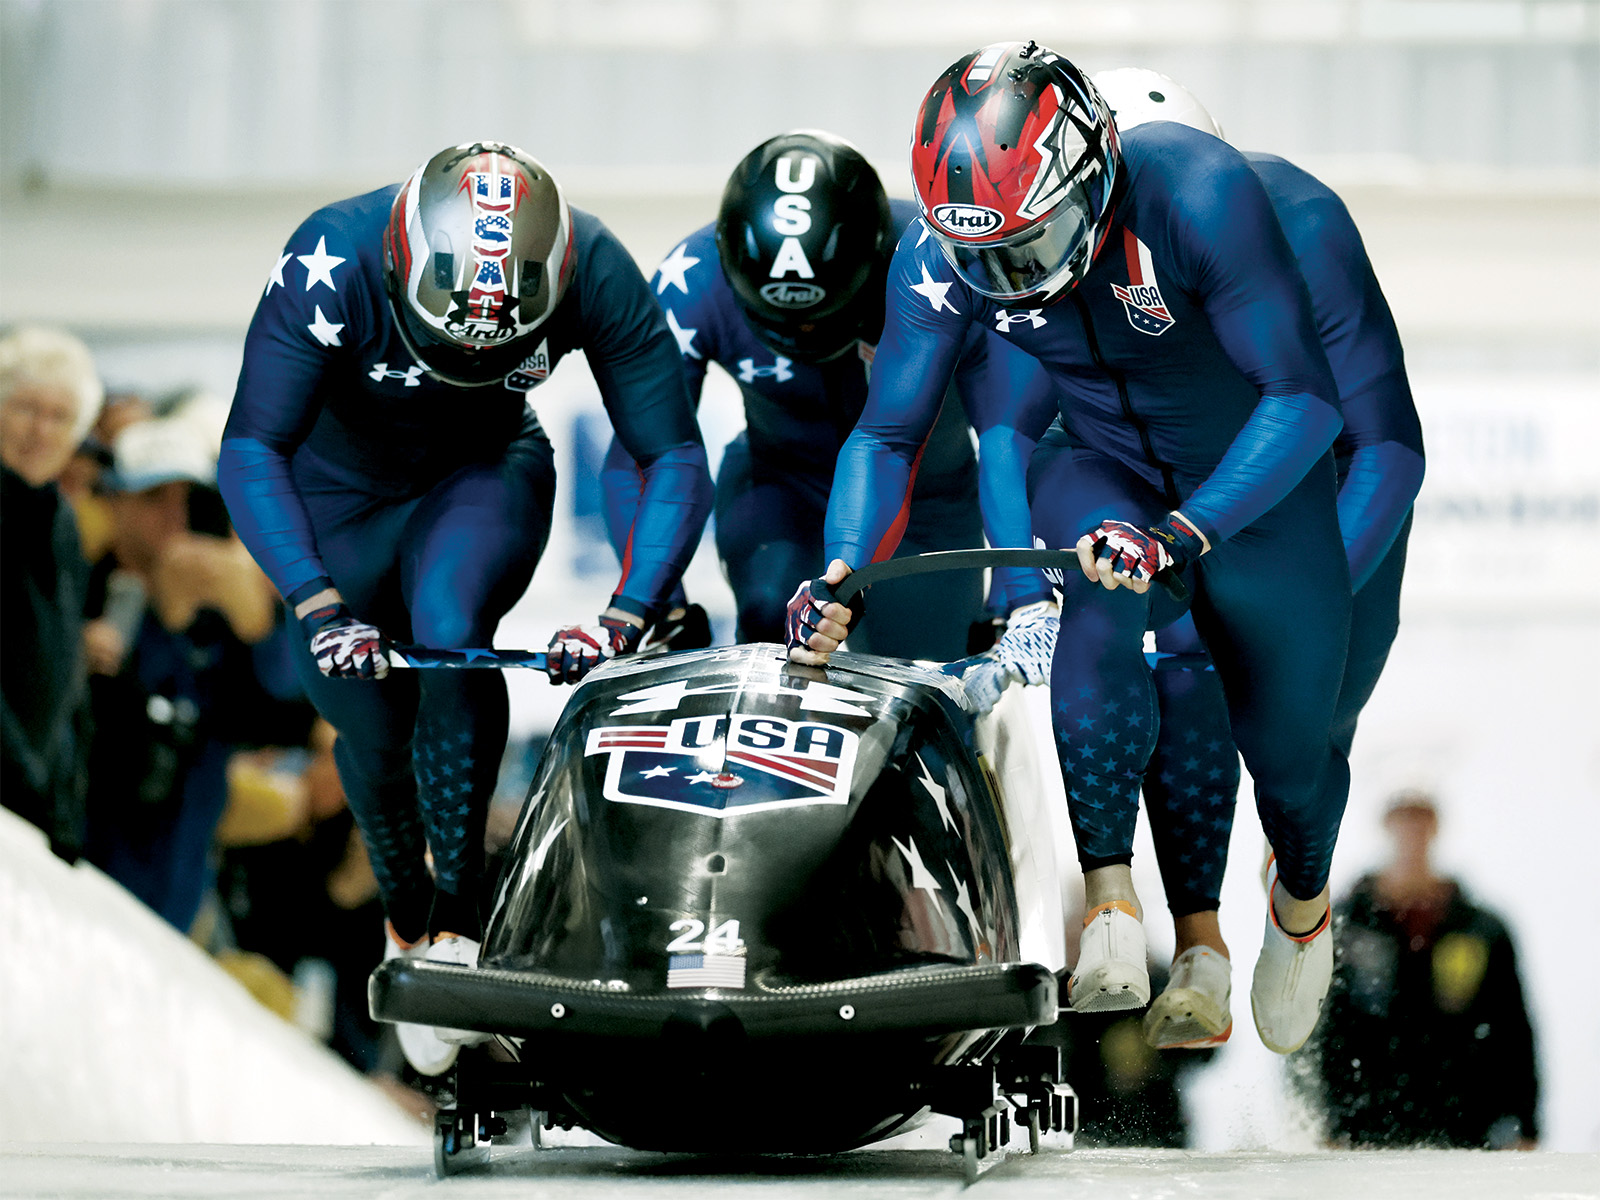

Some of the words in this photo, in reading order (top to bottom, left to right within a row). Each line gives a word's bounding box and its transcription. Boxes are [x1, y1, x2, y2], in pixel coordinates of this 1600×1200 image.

[769, 157, 816, 279] USA
[940, 209, 993, 227] Arai
[467, 172, 517, 305] USA
[1129, 286, 1163, 306] USA
[681, 718, 845, 759] USA
[666, 918, 745, 952] 24
